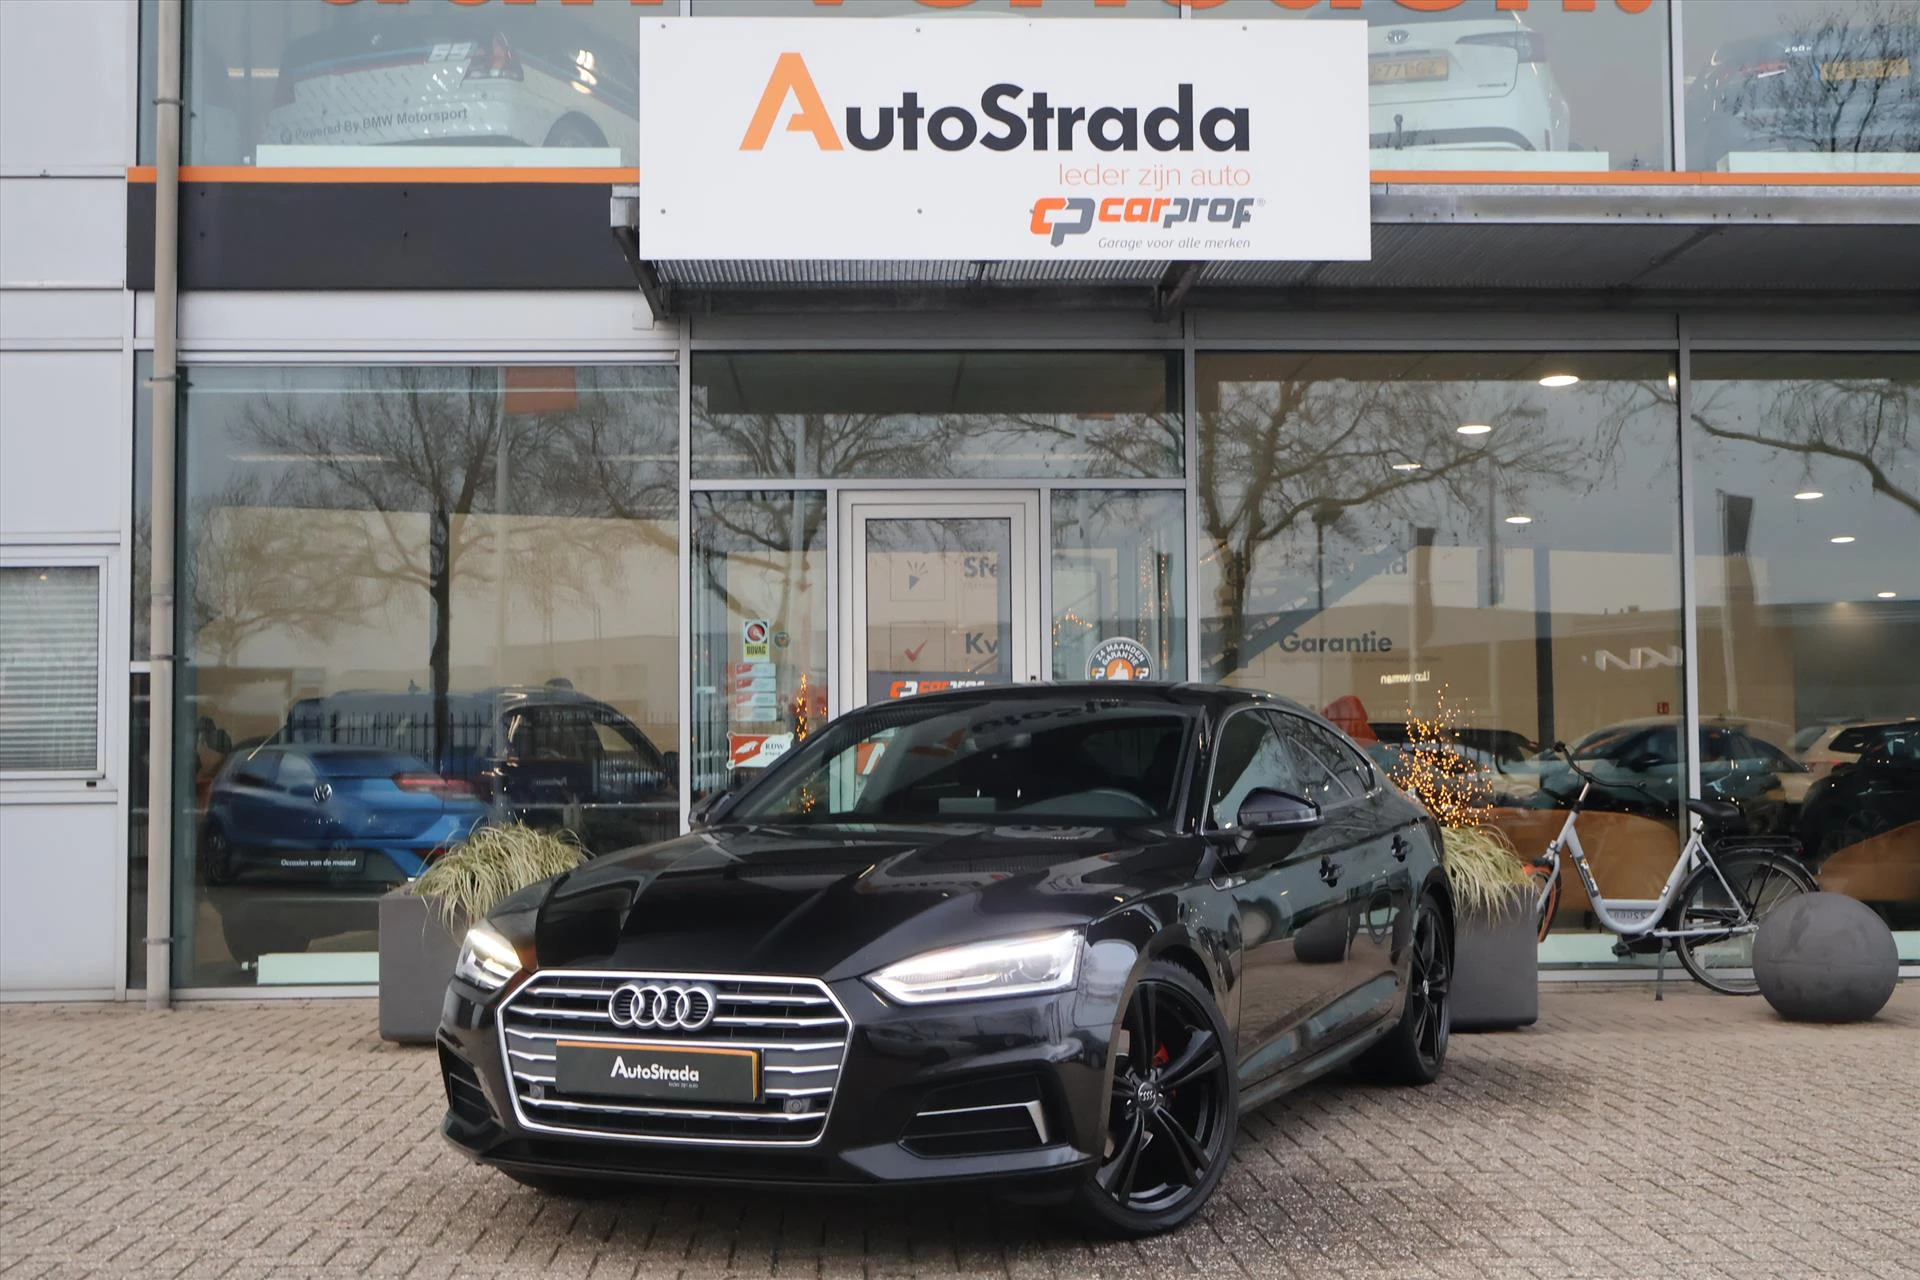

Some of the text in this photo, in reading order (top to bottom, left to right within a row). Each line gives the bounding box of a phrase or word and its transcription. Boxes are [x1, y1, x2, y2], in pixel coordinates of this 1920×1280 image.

[739, 52, 1250, 152] AutoStrada
[344, 118, 360, 133] By
[363, 113, 393, 130] BMW
[397, 107, 468, 126] Motorsport
[1058, 163, 1251, 191] Ieder zijn auto
[1098, 197, 1255, 229] carprof
[1098, 236, 1251, 252] Garage voor alle merken
[1095, 643, 1146, 662] 24 MAANDEN
[1279, 631, 1393, 653] Garantie
[1102, 650, 1140, 666] GARANTIE
[280, 858, 308, 867] Occasion
[323, 858, 332, 867] de
[332, 858, 357, 867] maand
[610, 1055, 700, 1082] AutoStrada
